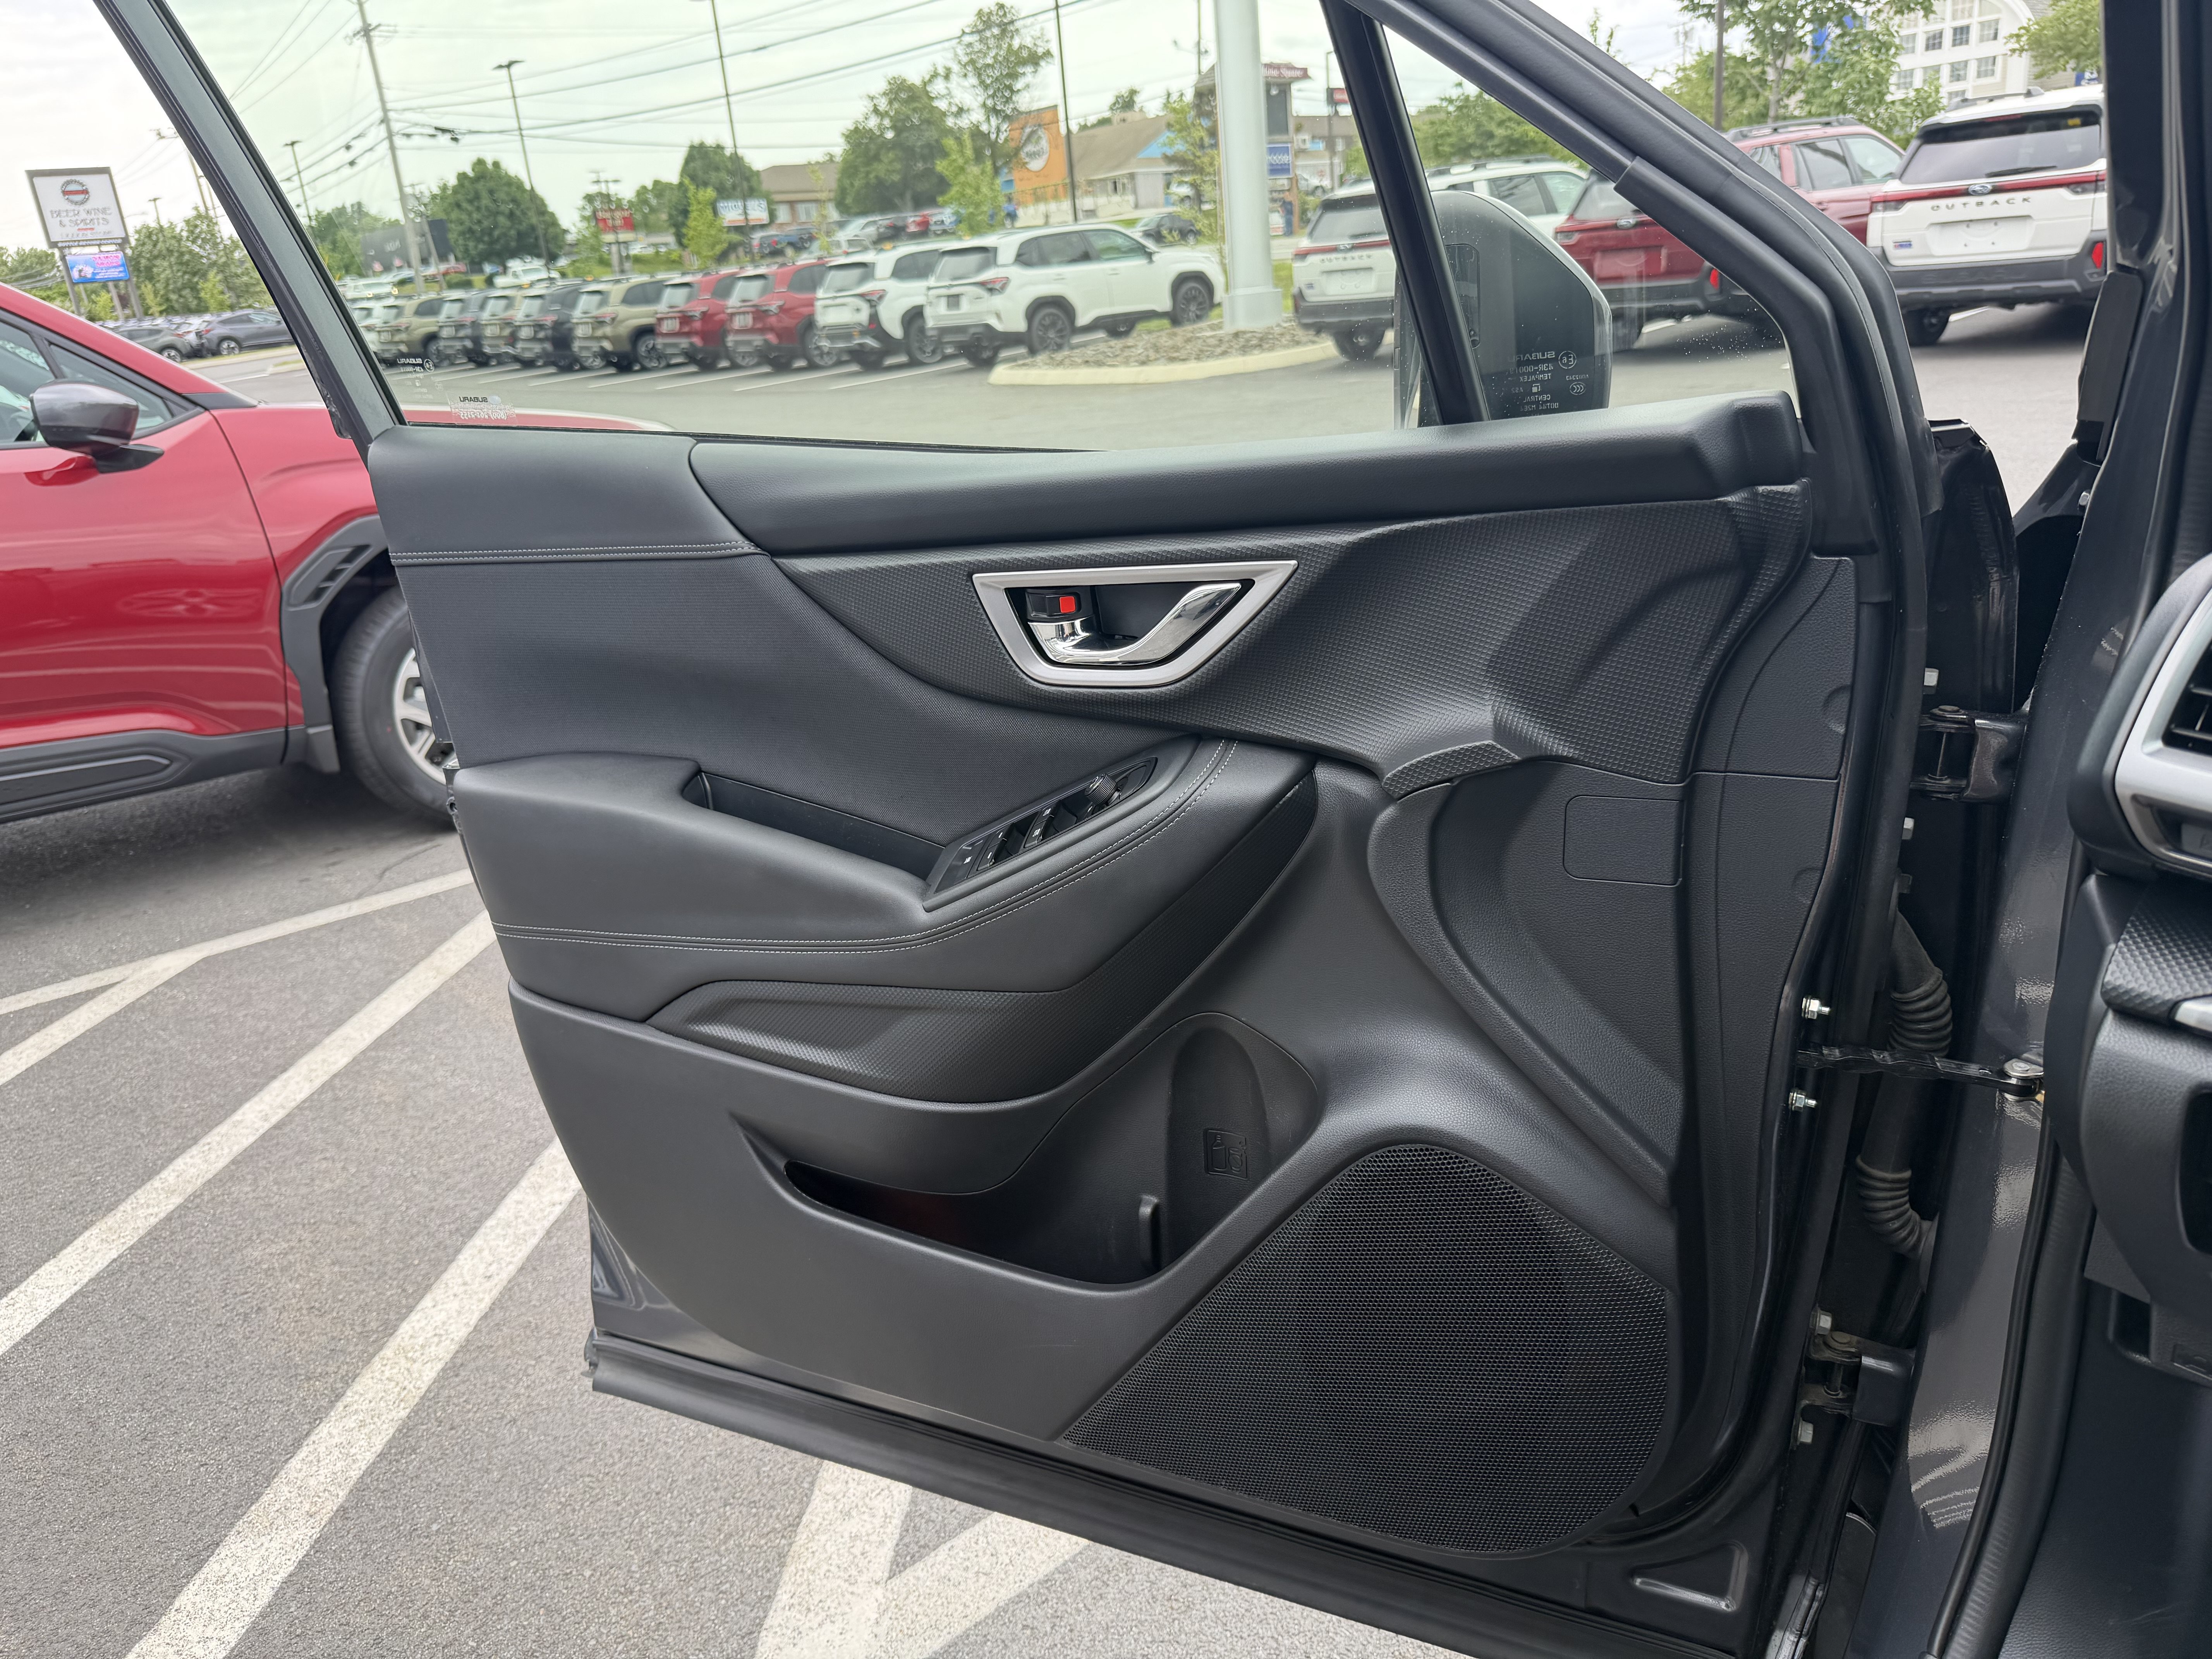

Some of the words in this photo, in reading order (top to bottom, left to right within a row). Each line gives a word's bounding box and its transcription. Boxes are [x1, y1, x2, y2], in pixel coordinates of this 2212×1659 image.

[1930, 196, 2032, 211] OUTBACK
[50, 209, 80, 219] BEER
[83, 206, 113, 216] WINE
[69, 217, 110, 227] SPIRITS
